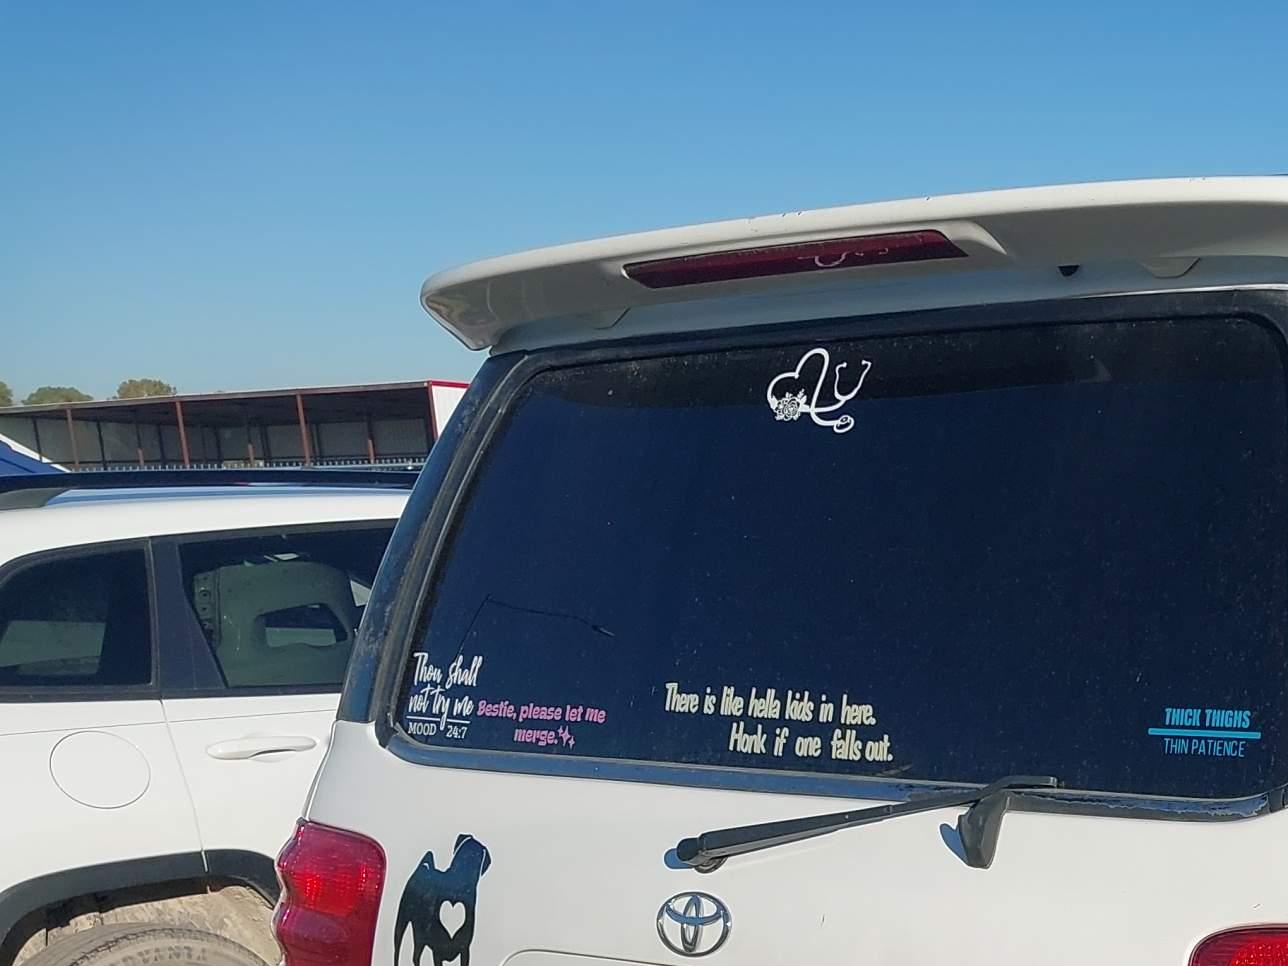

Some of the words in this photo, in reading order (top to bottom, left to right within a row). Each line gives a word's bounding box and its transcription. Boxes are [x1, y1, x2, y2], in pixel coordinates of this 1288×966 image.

[413, 652, 443, 686] Thou
[408, 683, 435, 713] not
[430, 685, 451, 731] try
[453, 696, 474, 717] me
[476, 700, 517, 720] Bestie,
[518, 703, 562, 722] please
[565, 705, 584, 722] let
[585, 707, 606, 723] me
[665, 682, 699, 714] There
[703, 686, 716, 715] is
[720, 686, 743, 716] like
[748, 687, 780, 719] hella
[785, 690, 814, 722] kids
[819, 694, 834, 723] in
[841, 694, 877, 726] here.
[408, 722, 437, 736] MOOD
[1165, 708, 1201, 726] THICK
[1205, 709, 1251, 728] THIGHS
[514, 728, 558, 746] merge.
[729, 722, 767, 754] Honk
[774, 727, 789, 757] if
[795, 735, 821, 757] one
[831, 729, 862, 761] falls
[865, 734, 894, 762] out.
[1164, 738, 1189, 755] THIN
[1191, 739, 1246, 758] PATIENCE
